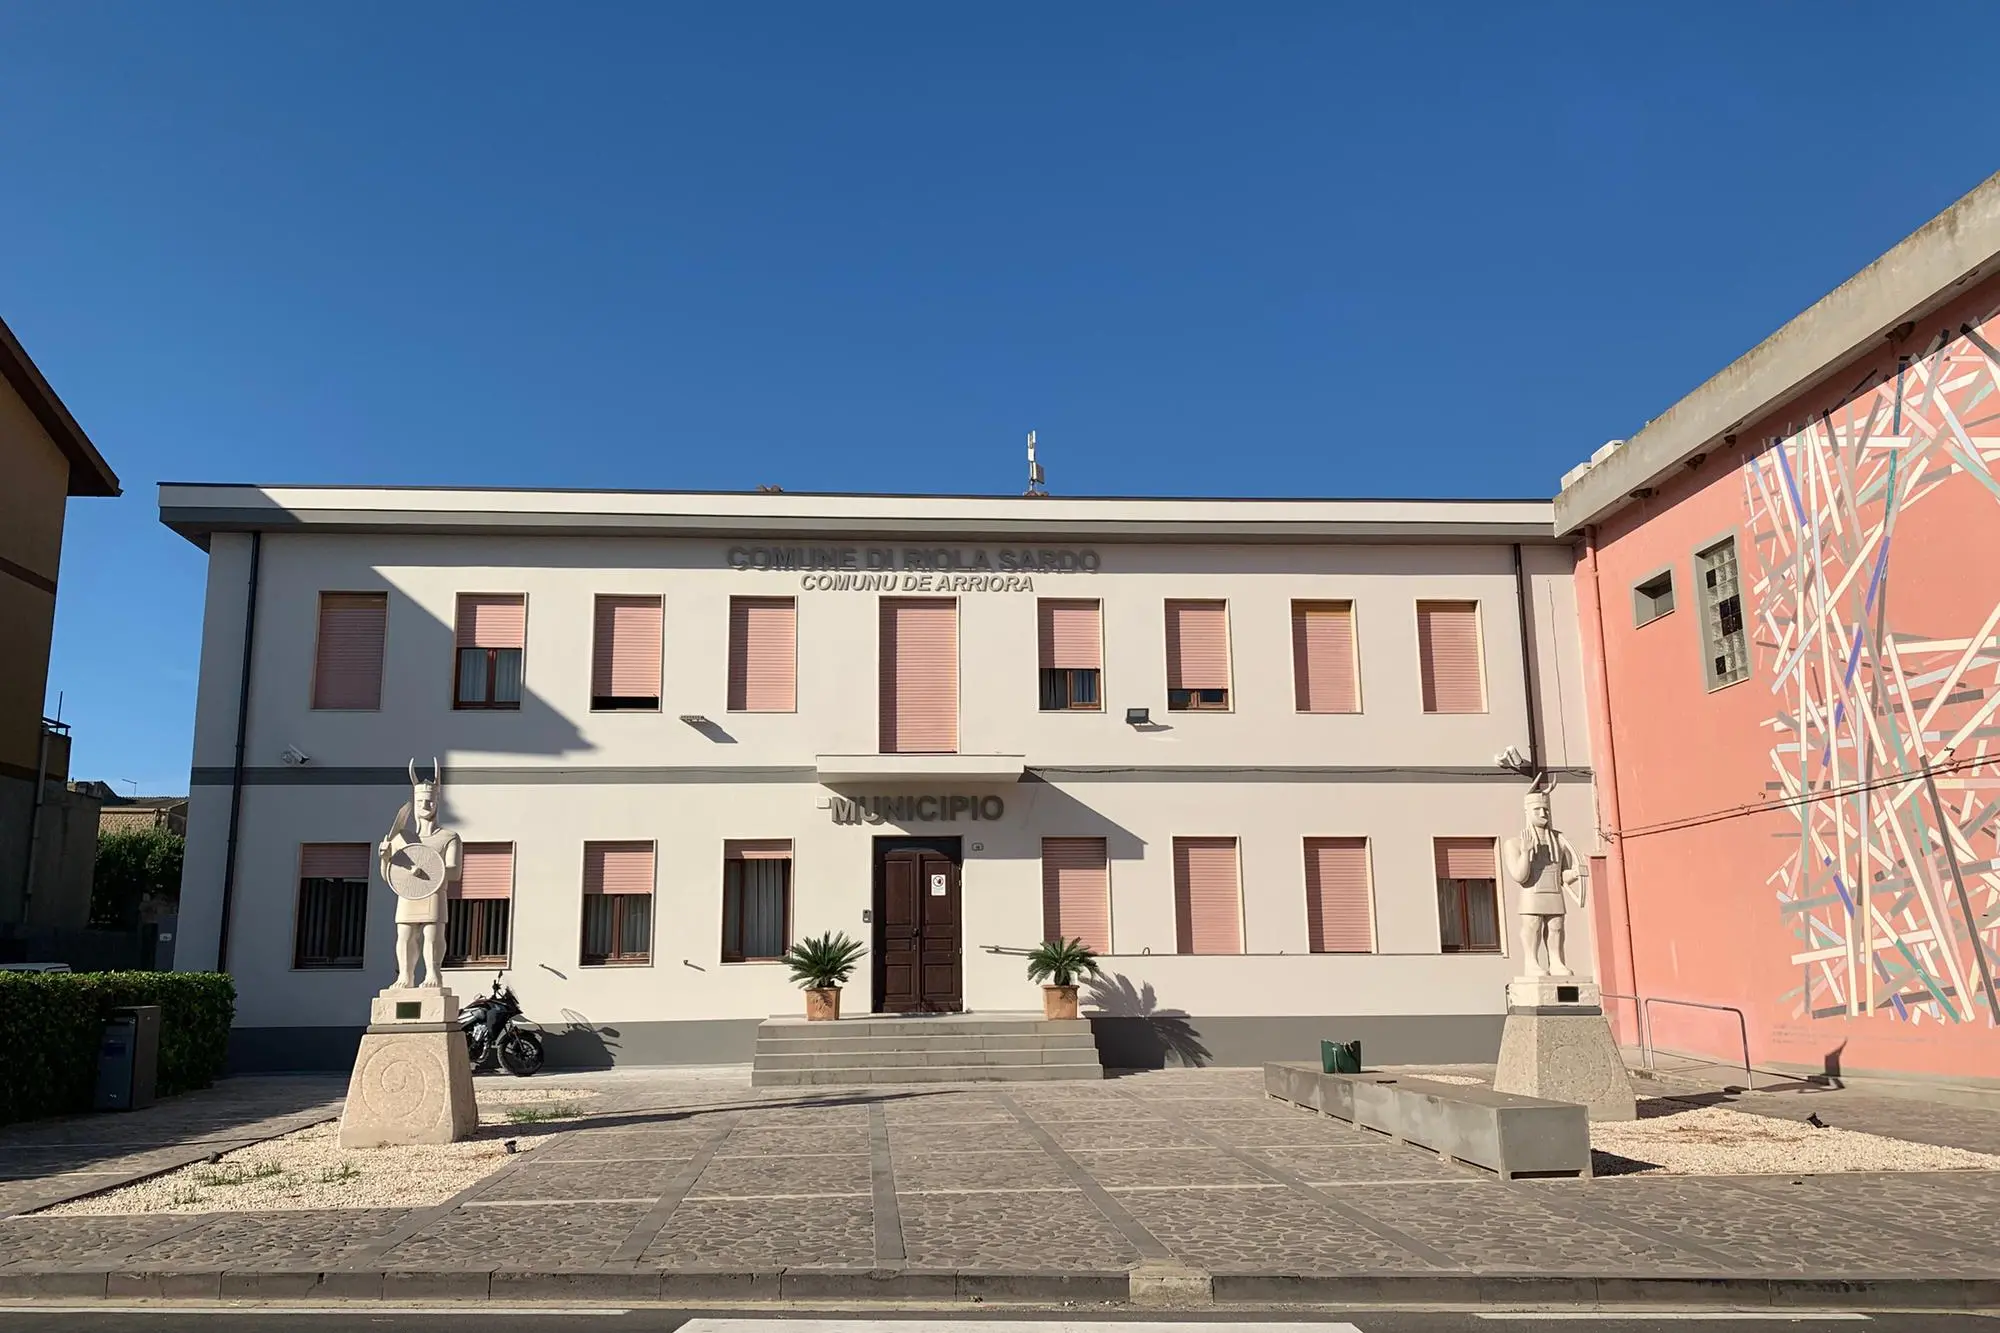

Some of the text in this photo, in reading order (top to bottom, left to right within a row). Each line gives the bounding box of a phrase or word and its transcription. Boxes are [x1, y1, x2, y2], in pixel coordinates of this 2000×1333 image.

[728, 545, 1100, 573] COMUNE DI RIOLA SARDO
[800, 573, 1034, 592] COMUNU DE ARRIORA
[831, 795, 1005, 823] MUNICIPIO
